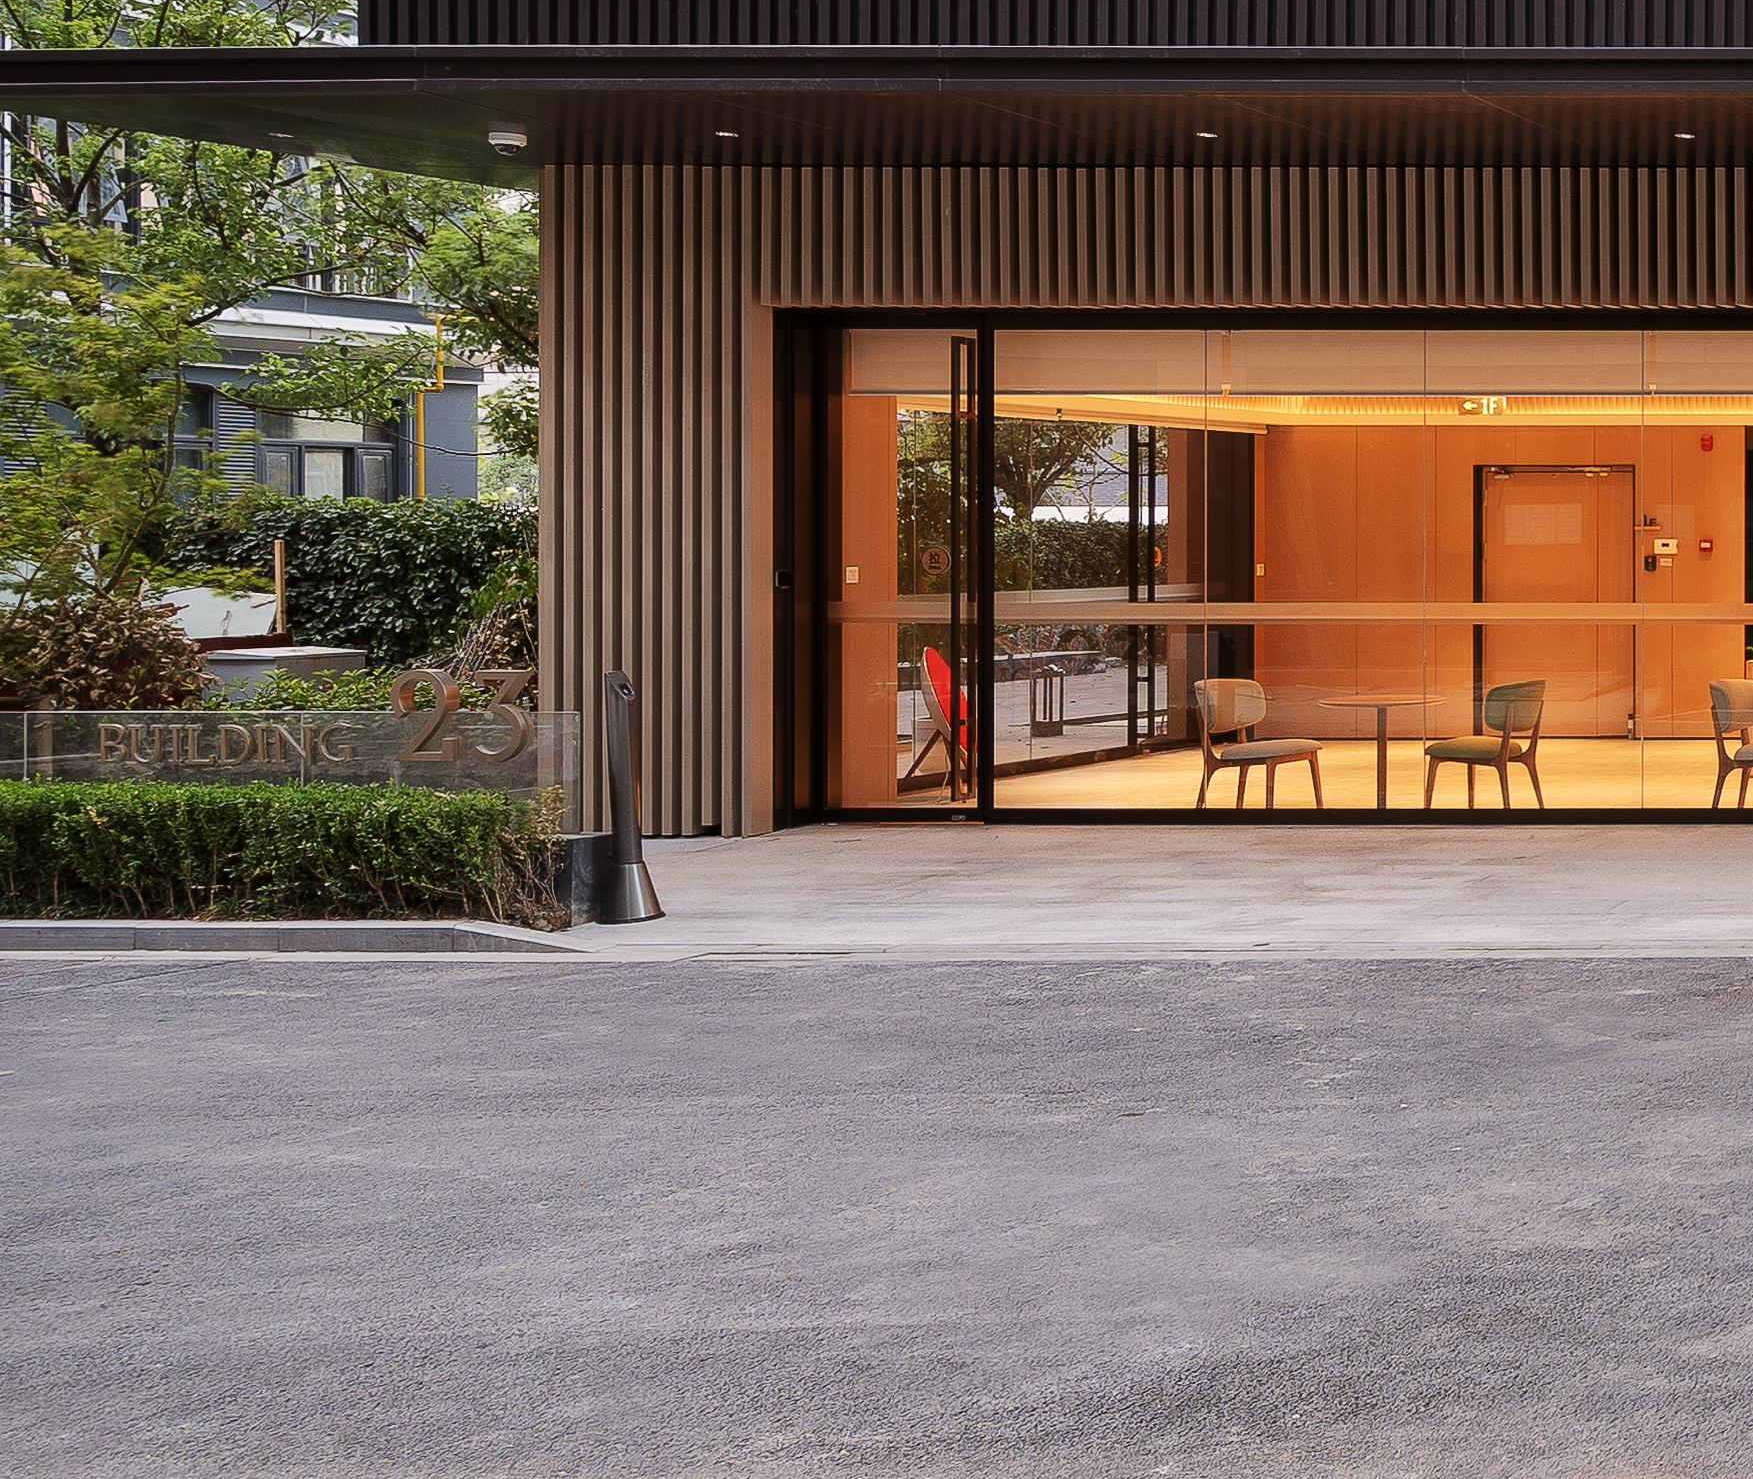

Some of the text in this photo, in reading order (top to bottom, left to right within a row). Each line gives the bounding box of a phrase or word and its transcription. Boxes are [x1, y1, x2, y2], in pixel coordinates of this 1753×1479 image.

[1480, 397, 1499, 415] 1F
[100, 668, 536, 766] BUILDING 23
